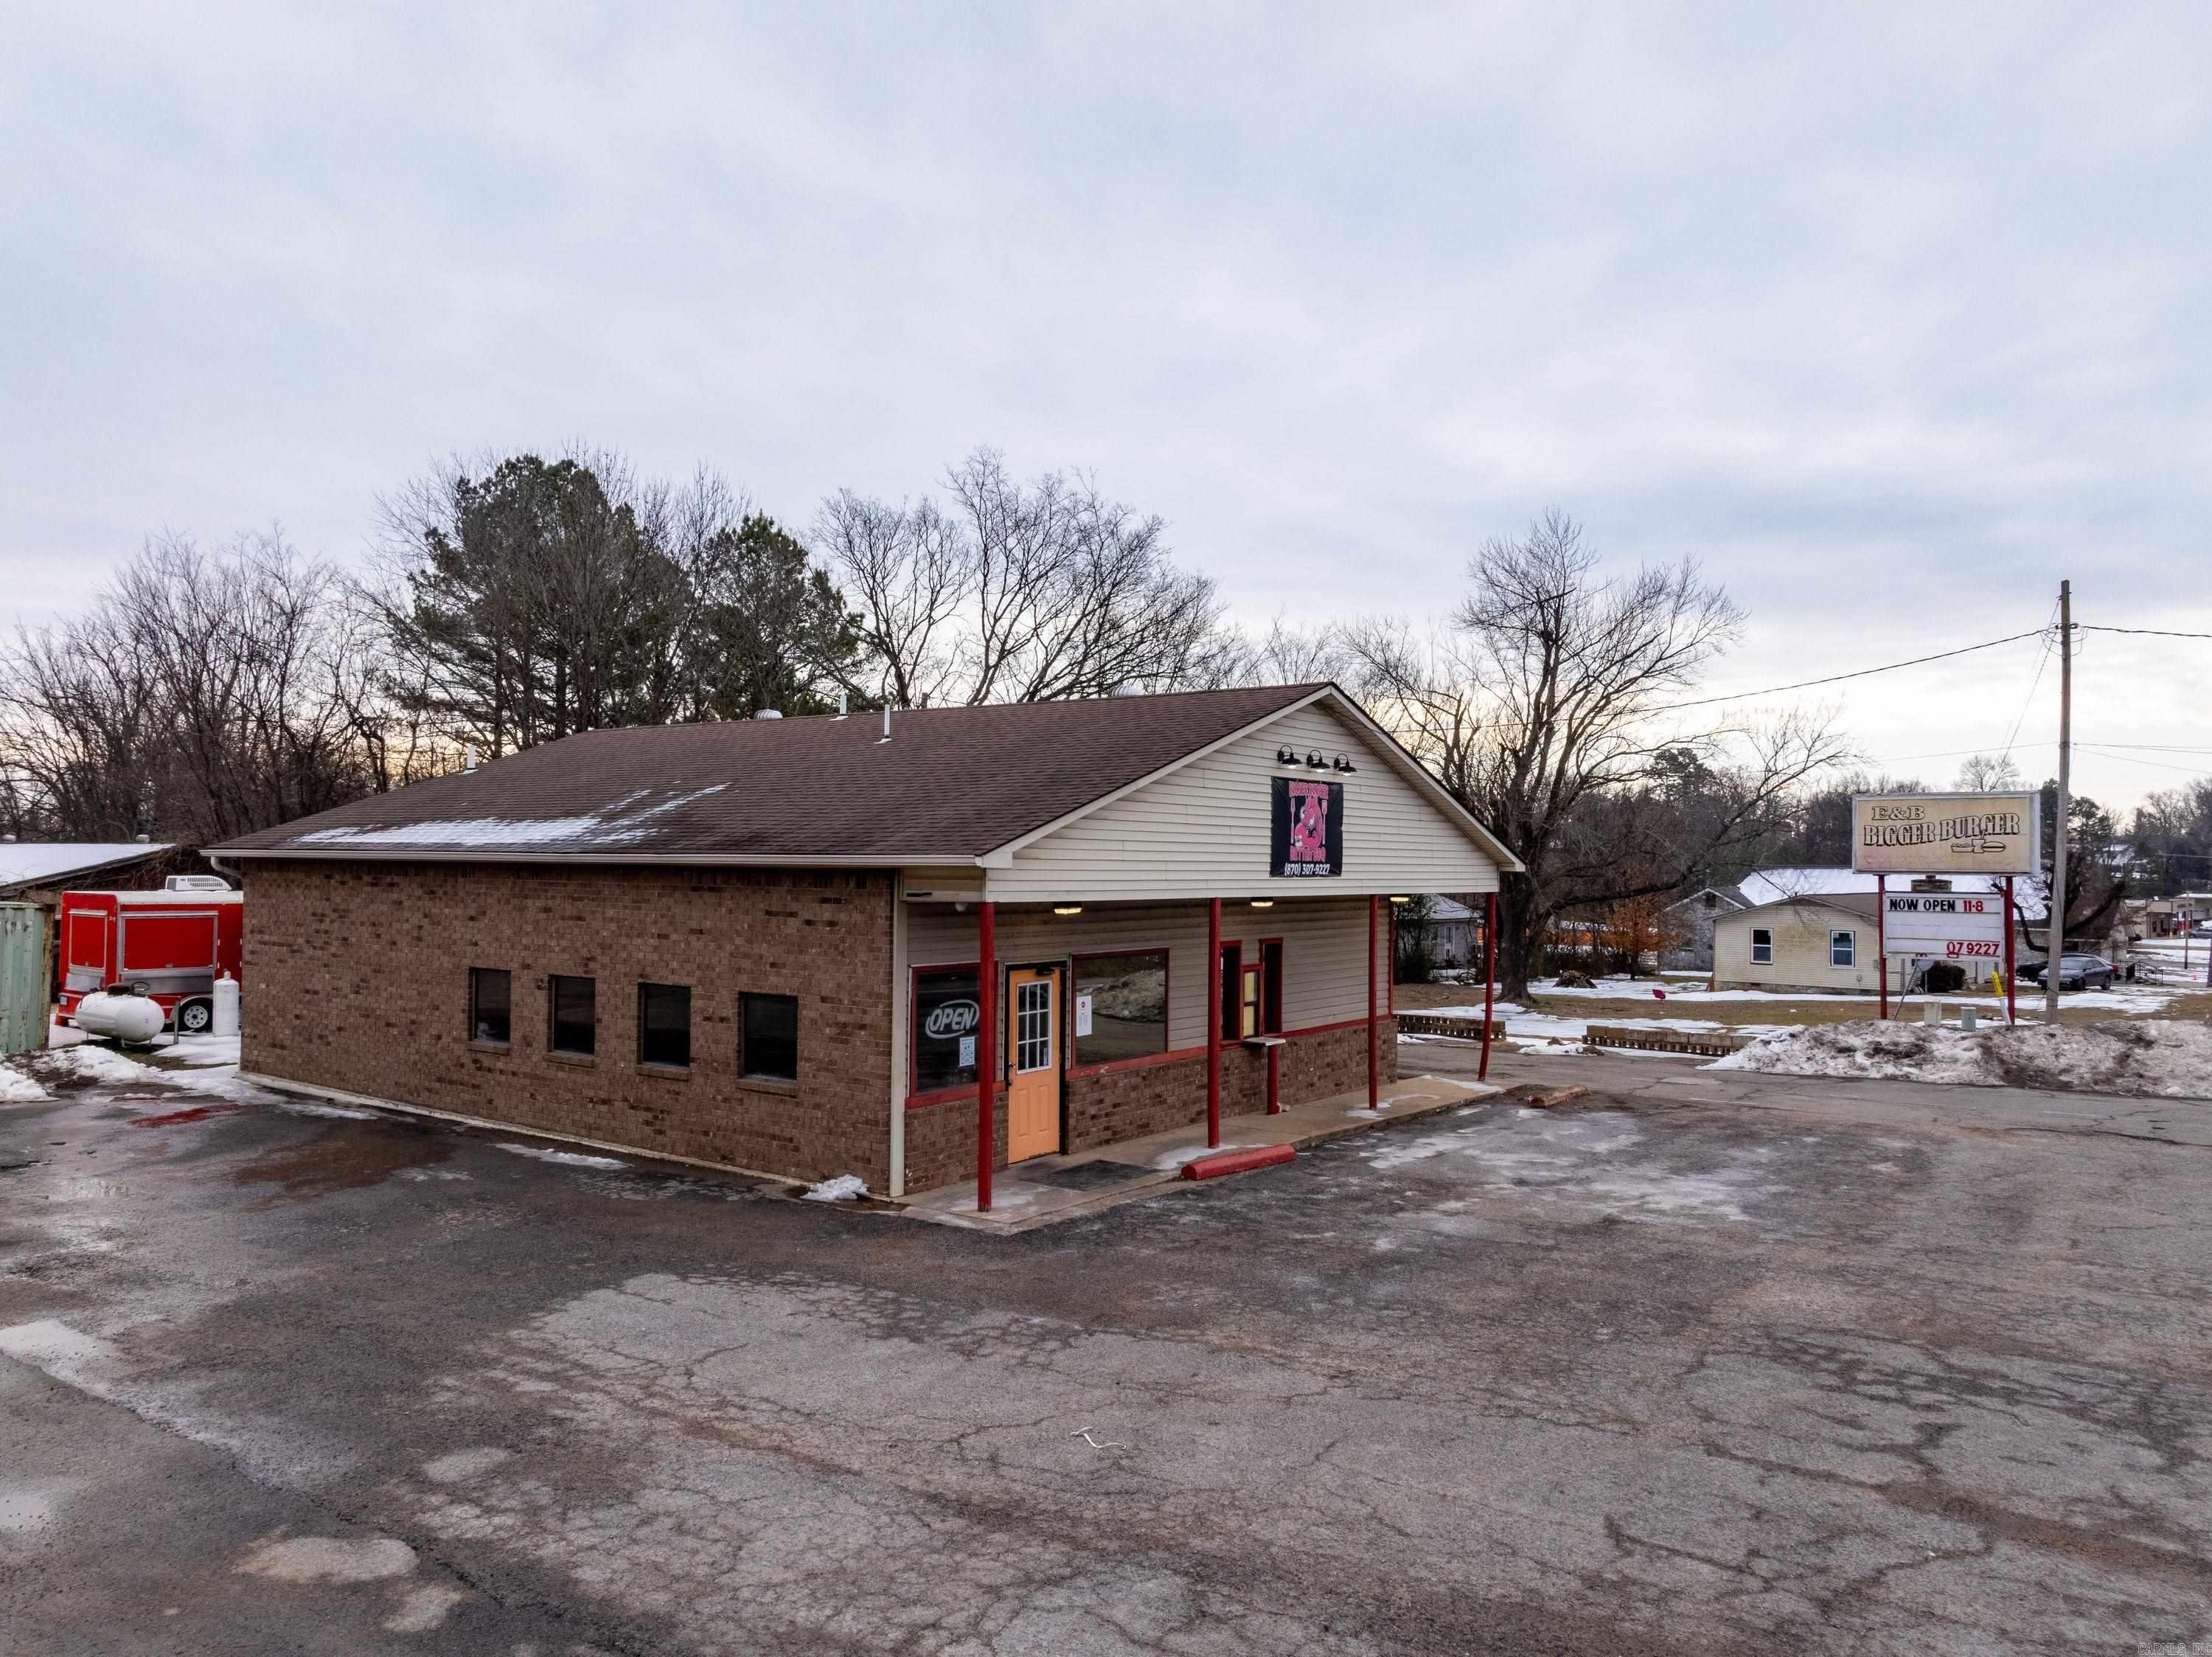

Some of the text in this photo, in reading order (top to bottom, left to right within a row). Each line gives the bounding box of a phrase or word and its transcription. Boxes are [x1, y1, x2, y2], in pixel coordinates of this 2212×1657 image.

[1871, 806, 1926, 821] E&B
[1864, 813, 2020, 847] BIGGER BURGER
[1284, 862, 1330, 876] (870) 307-9227
[1889, 898, 1919, 911] NOW
[1923, 899, 1956, 911] OPEN
[1966, 942, 2000, 956] 9227
[929, 1007, 975, 1032] OPEN
